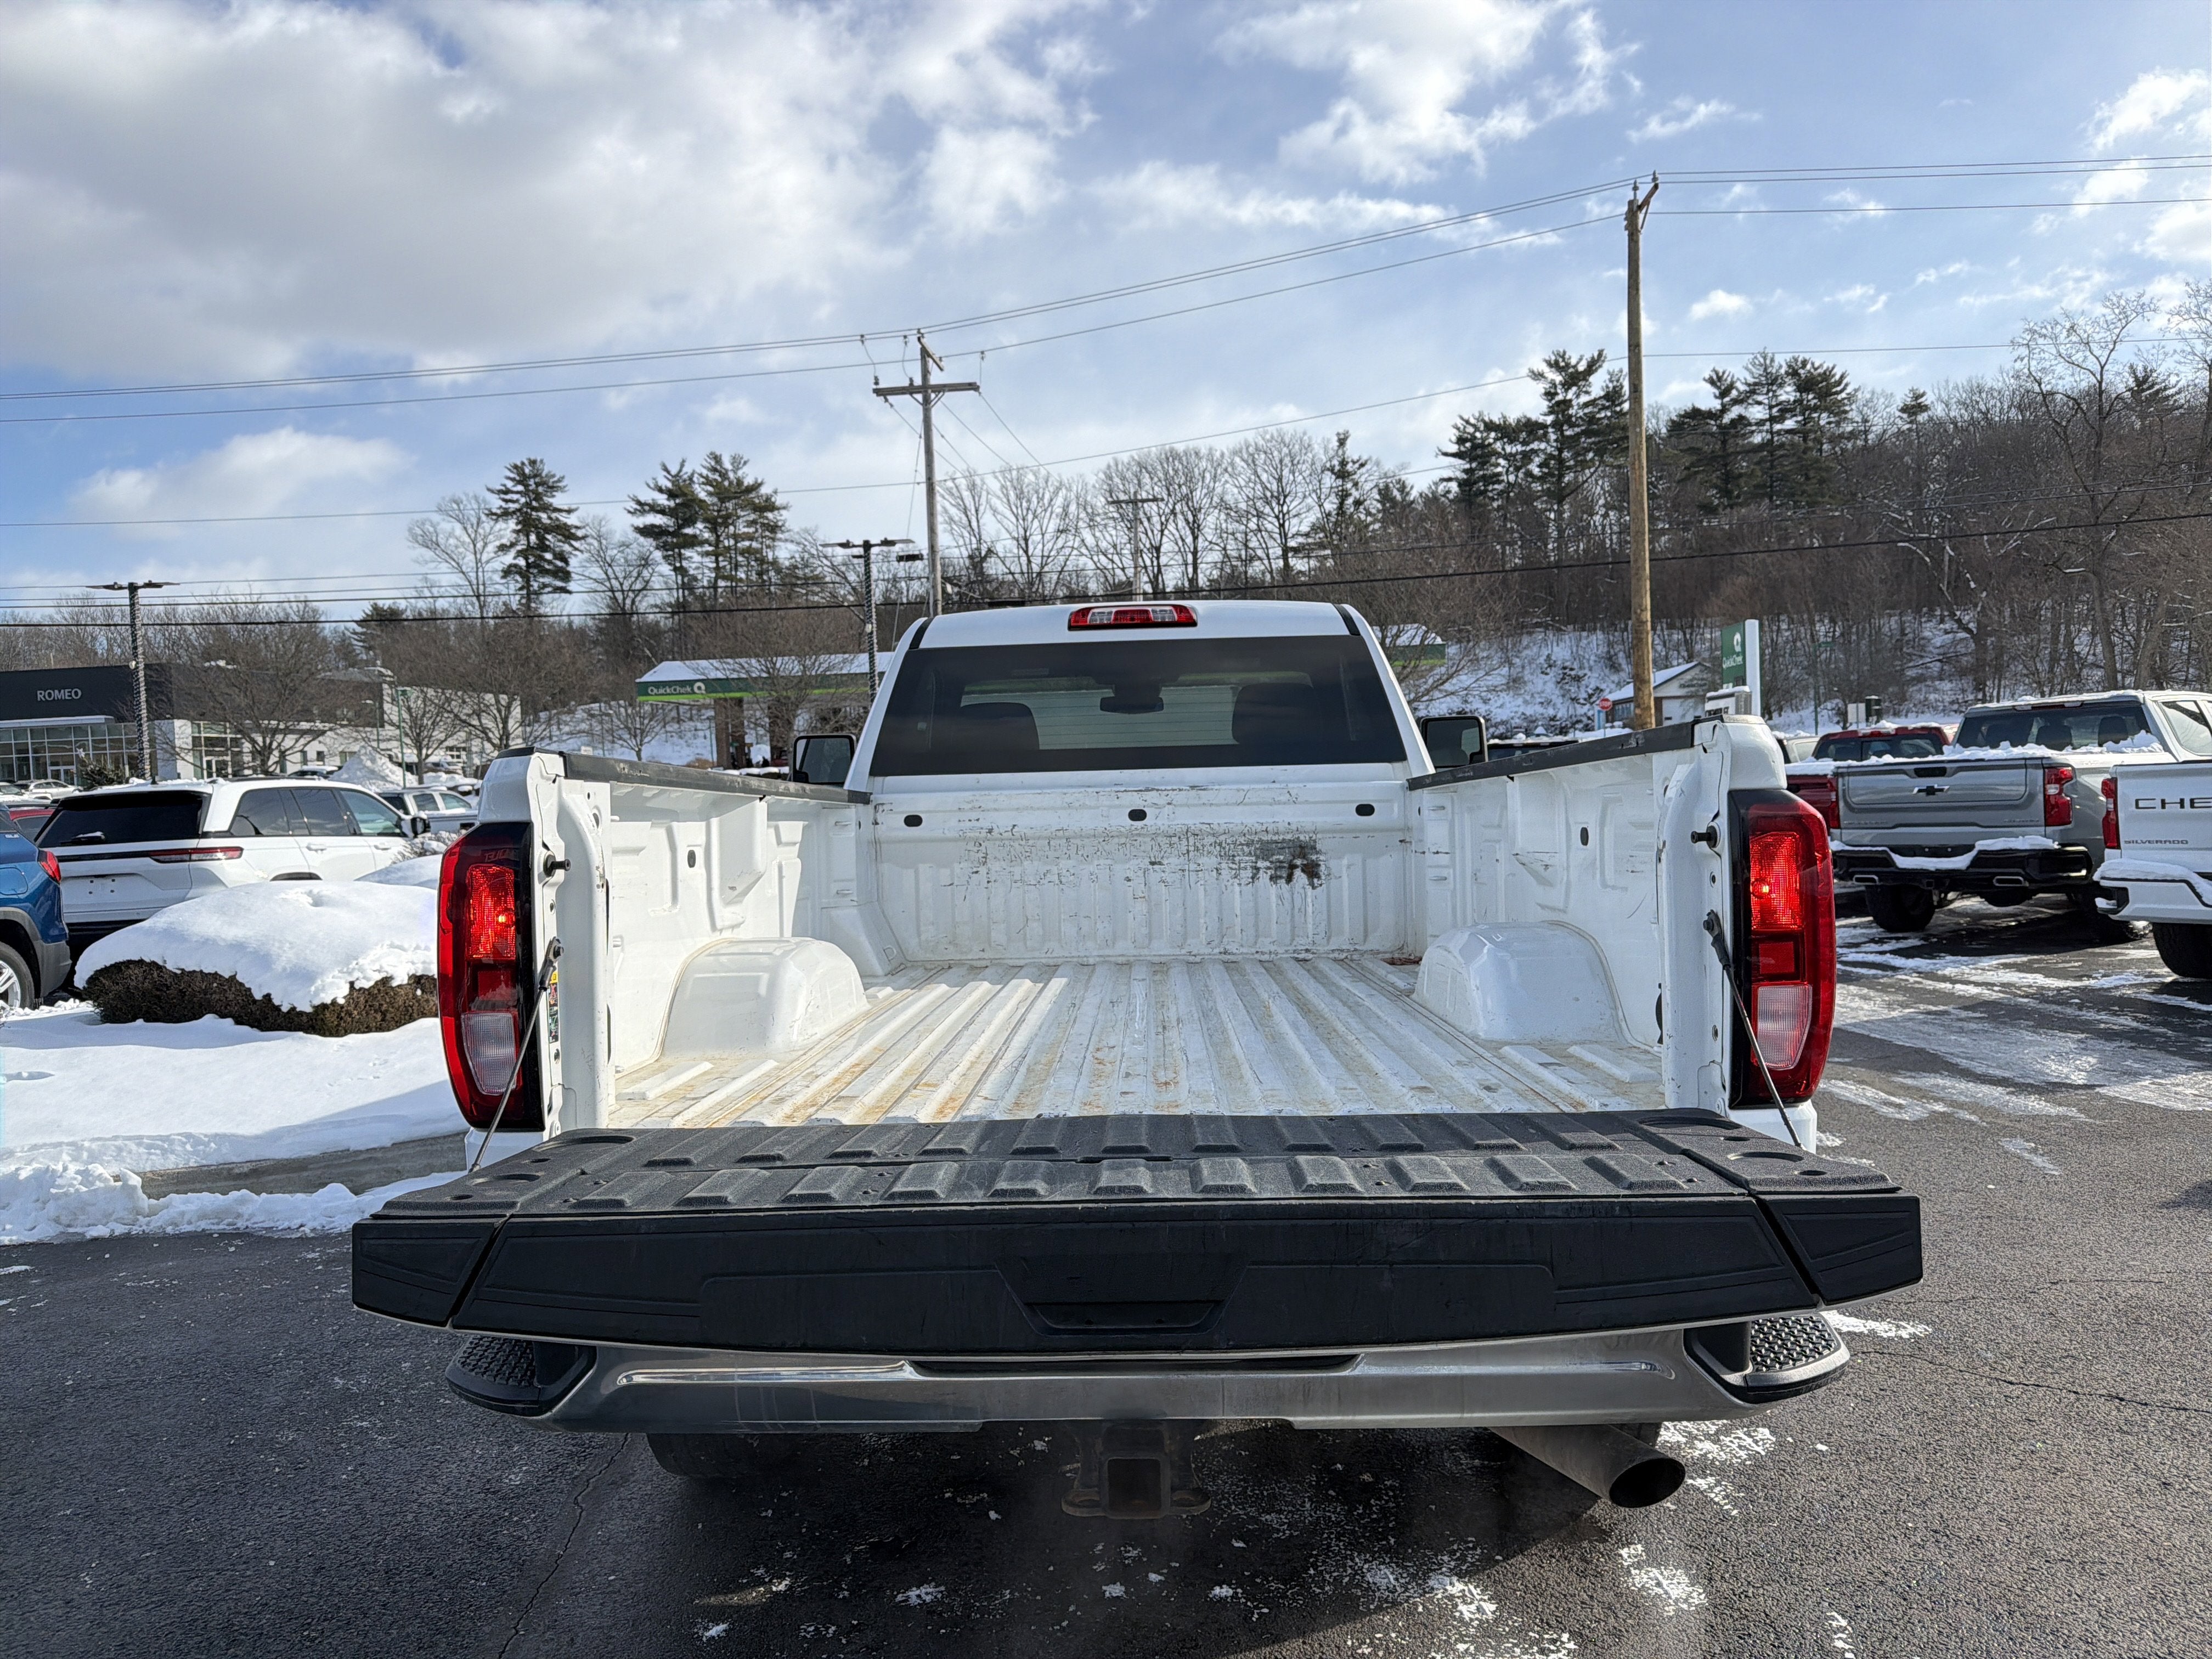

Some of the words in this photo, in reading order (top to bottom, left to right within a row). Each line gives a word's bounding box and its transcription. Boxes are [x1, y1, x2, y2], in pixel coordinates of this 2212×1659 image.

[37, 689, 82, 701] ROMEO
[648, 685, 693, 696] QuickChek
[2135, 797, 2212, 809] CHE
